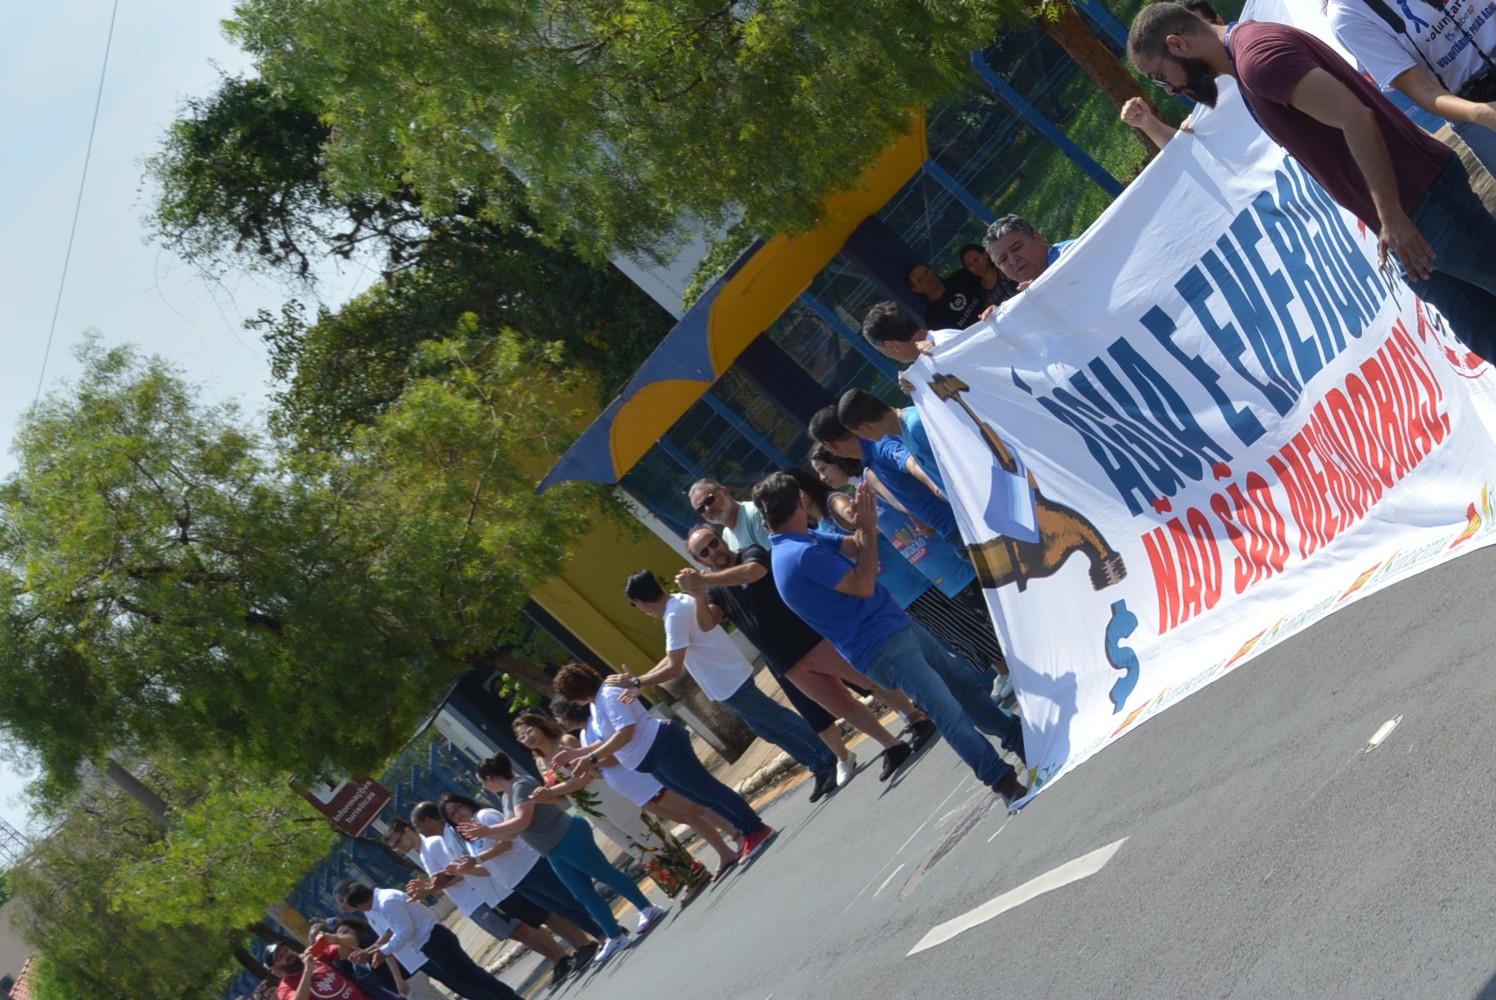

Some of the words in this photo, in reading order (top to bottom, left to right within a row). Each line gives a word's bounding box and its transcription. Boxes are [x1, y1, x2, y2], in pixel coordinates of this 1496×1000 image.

[1174, 154, 1387, 417] ENERGIA
[1011, 336, 1234, 517] ÁGUA
[1139, 304, 1267, 447] E
[1141, 495, 1223, 636] NÃO
[1210, 461, 1290, 595] SÃO
[332, 780, 373, 822] Informações
